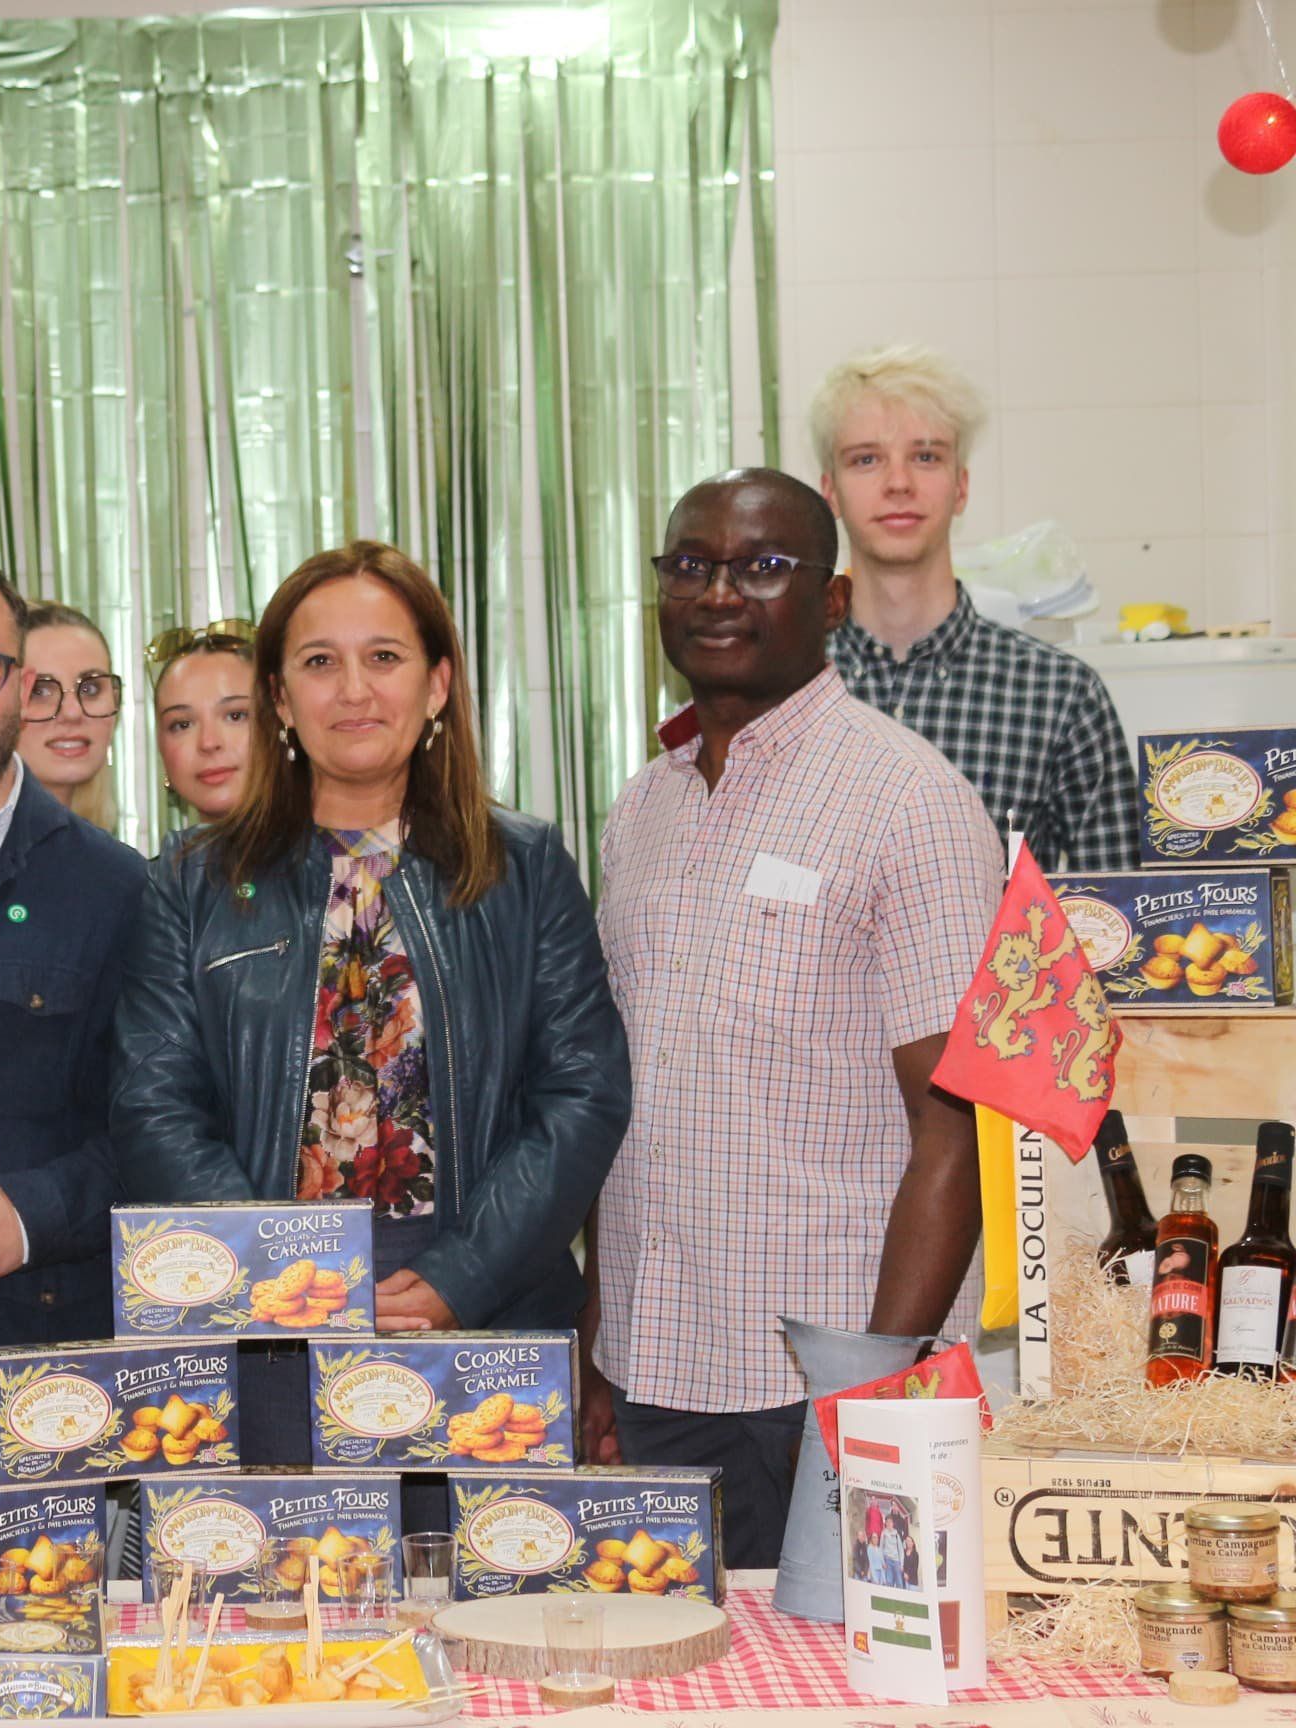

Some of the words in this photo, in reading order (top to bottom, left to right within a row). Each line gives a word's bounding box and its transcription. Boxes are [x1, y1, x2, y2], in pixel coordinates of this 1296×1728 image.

[1265, 748, 1296, 771] PET
[1134, 890, 1194, 917] PETITS
[1198, 881, 1258, 907] FOURS
[1020, 1126, 1047, 1281] SOCULEN
[258, 1213, 343, 1239] COOKIES
[268, 1239, 342, 1260] CARAMEL
[1152, 1293, 1199, 1312] ATURE
[1025, 1301, 1048, 1344] LA
[454, 1346, 540, 1372] COOKIES
[115, 1363, 170, 1392] PETITS
[173, 1353, 228, 1379] FOURS
[465, 1373, 540, 1394] CARAMEL
[1075, 1478, 1111, 1488] DEPUIS
[42, 1494, 96, 1520] FOURS
[269, 1494, 327, 1520] PETITS
[331, 1487, 389, 1511] FOURS
[577, 1496, 636, 1521] PETITS
[640, 1490, 699, 1515] FOURS
[1216, 1537, 1275, 1551] Campagnar
[1218, 1549, 1259, 1557] Calvados
[1143, 1623, 1203, 1639] ampagnarde
